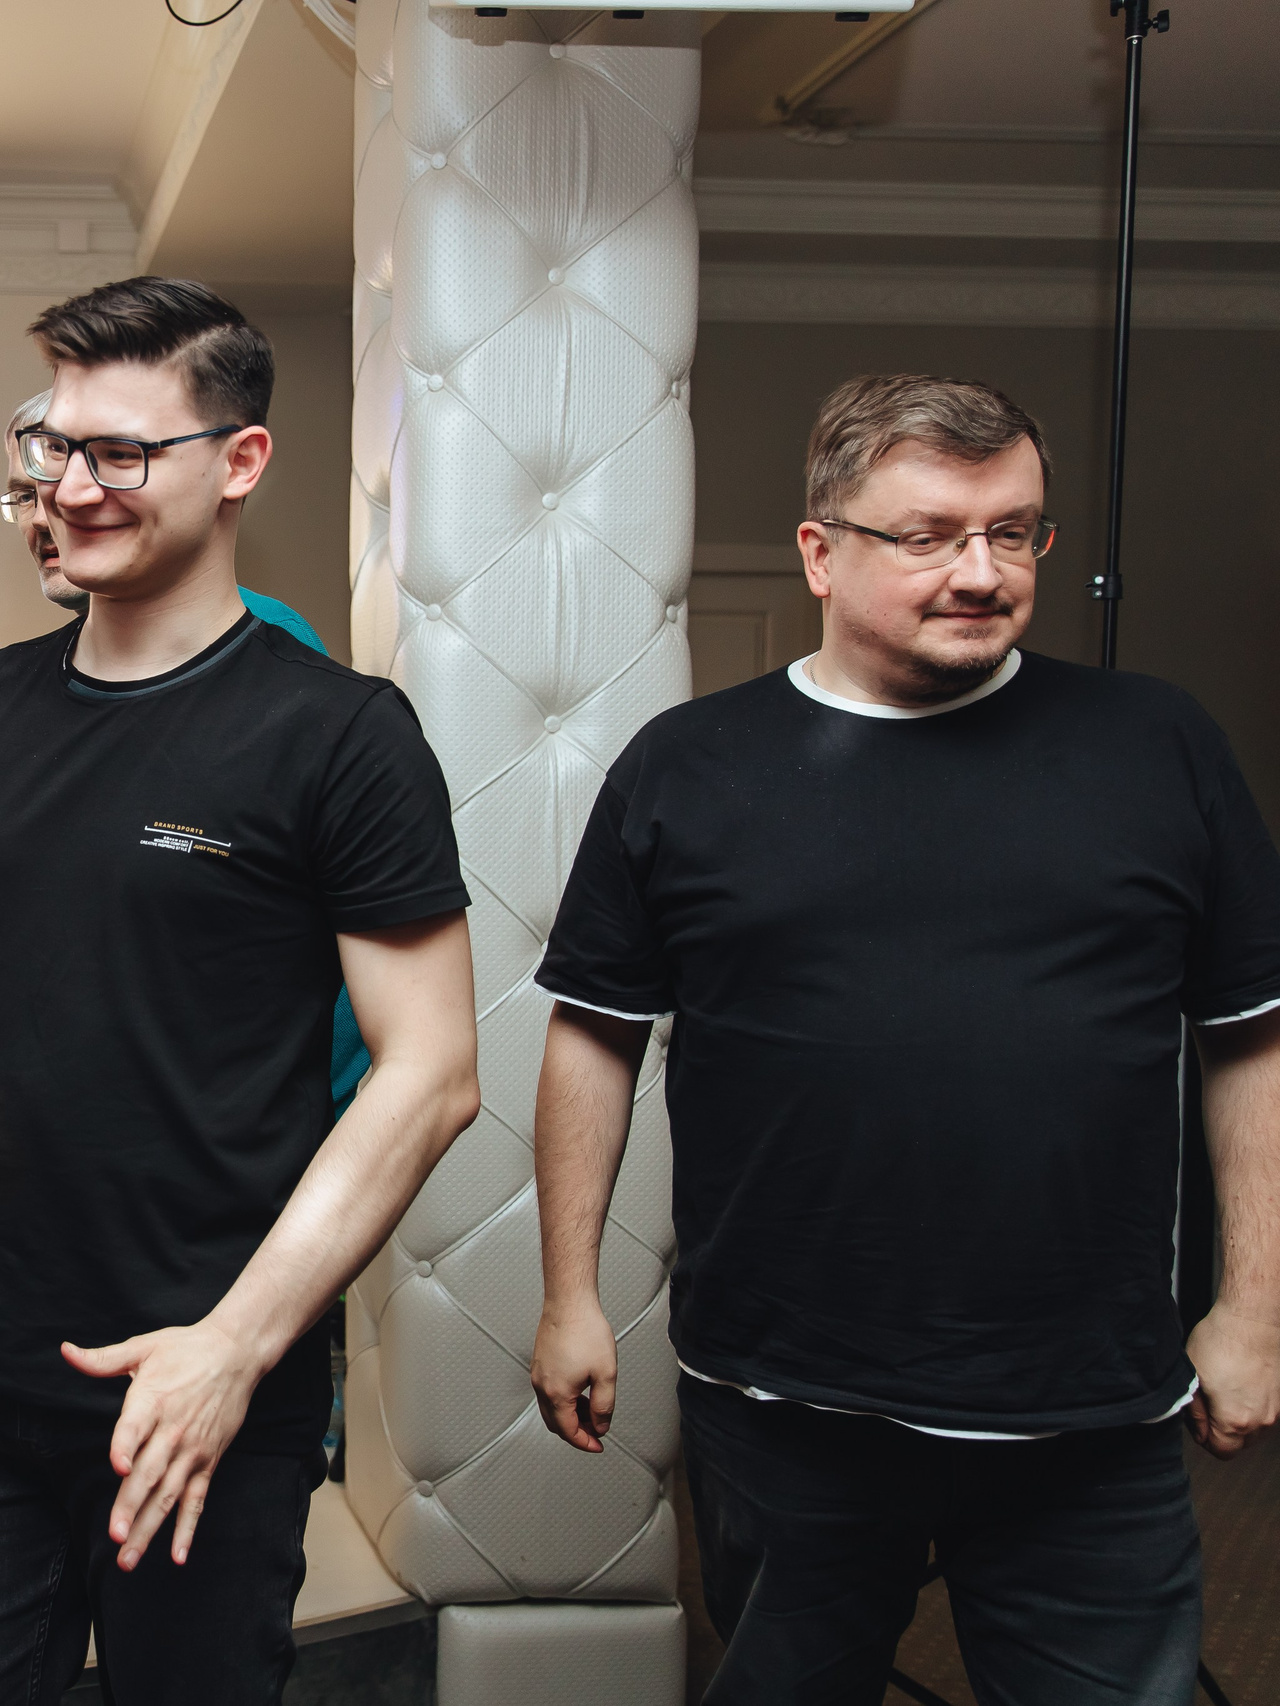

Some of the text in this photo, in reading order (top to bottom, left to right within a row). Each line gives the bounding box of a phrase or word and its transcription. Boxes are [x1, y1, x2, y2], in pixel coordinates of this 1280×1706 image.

[153, 821, 204, 835] BRAND SPORTS
[206, 846, 218, 855] FOR
[217, 849, 230, 858] YOU
